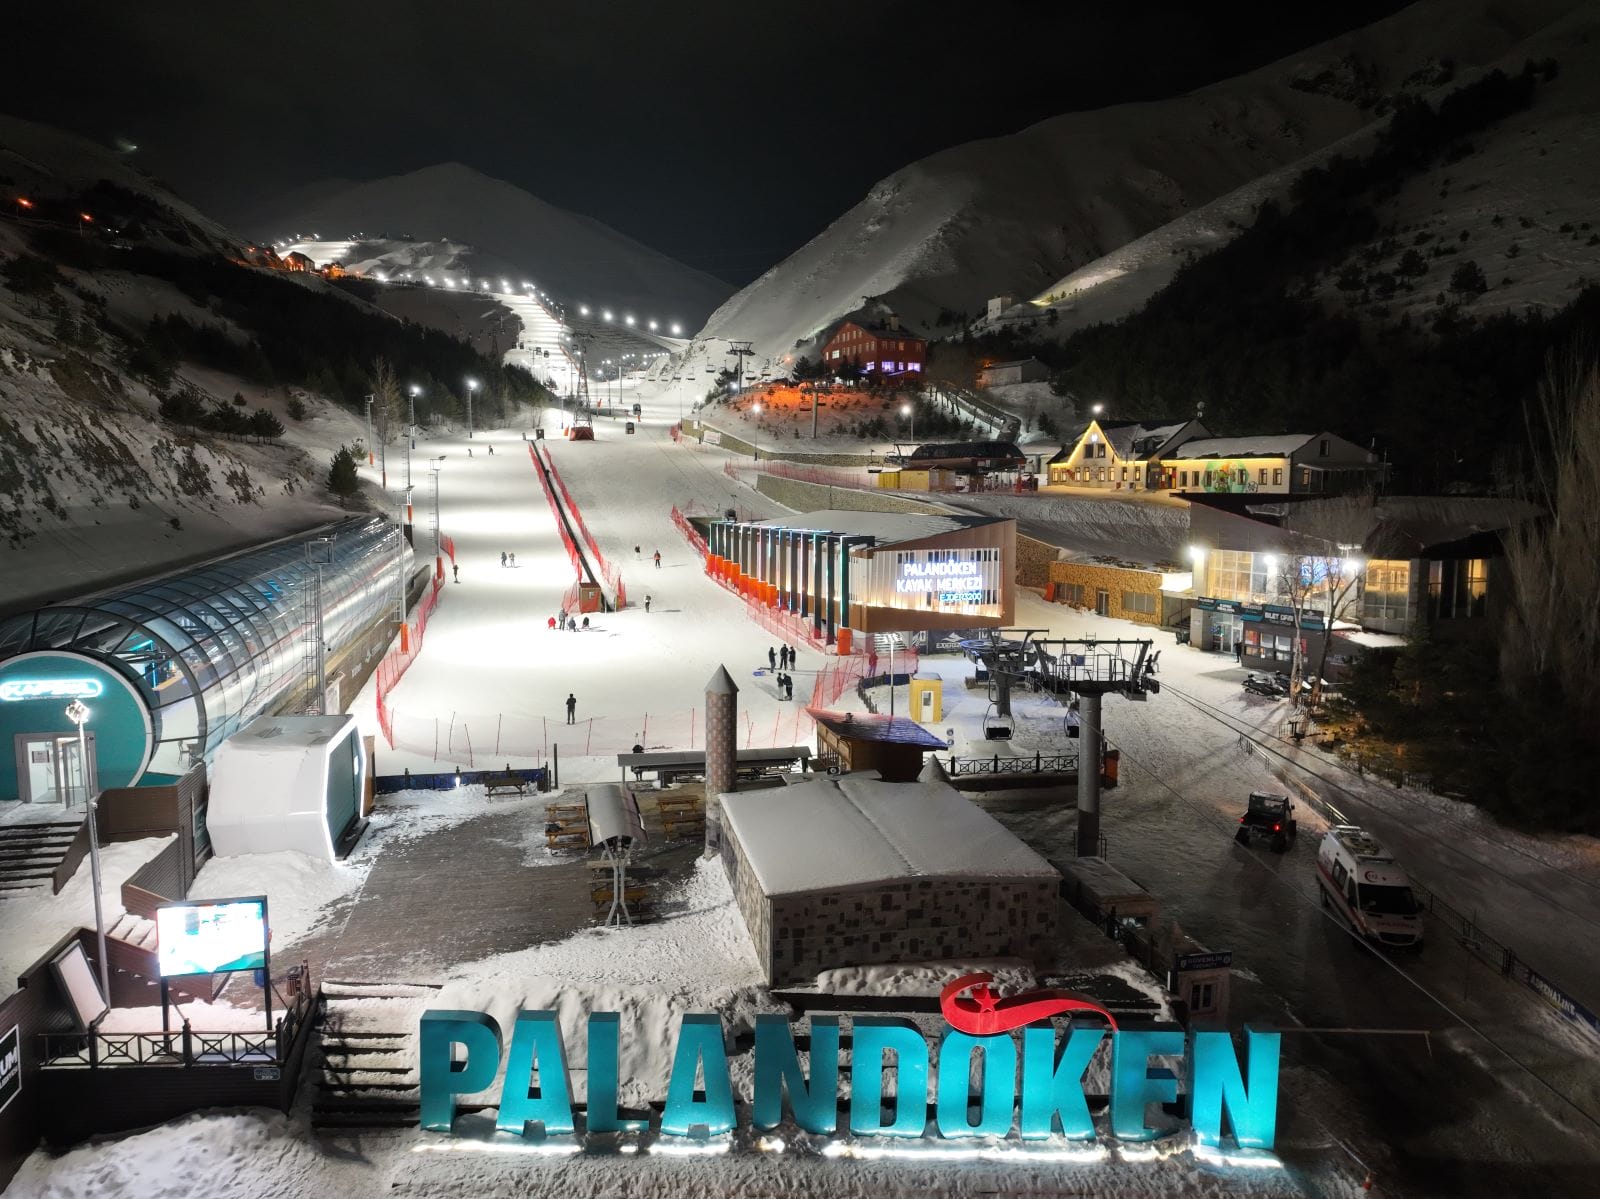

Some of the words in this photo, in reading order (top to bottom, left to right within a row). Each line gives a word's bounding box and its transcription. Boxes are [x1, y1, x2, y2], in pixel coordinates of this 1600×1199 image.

[904, 559, 977, 576] PALANDÖKEN
[896, 579, 933, 592] KAYAK
[937, 576, 982, 590] MERKEZİ
